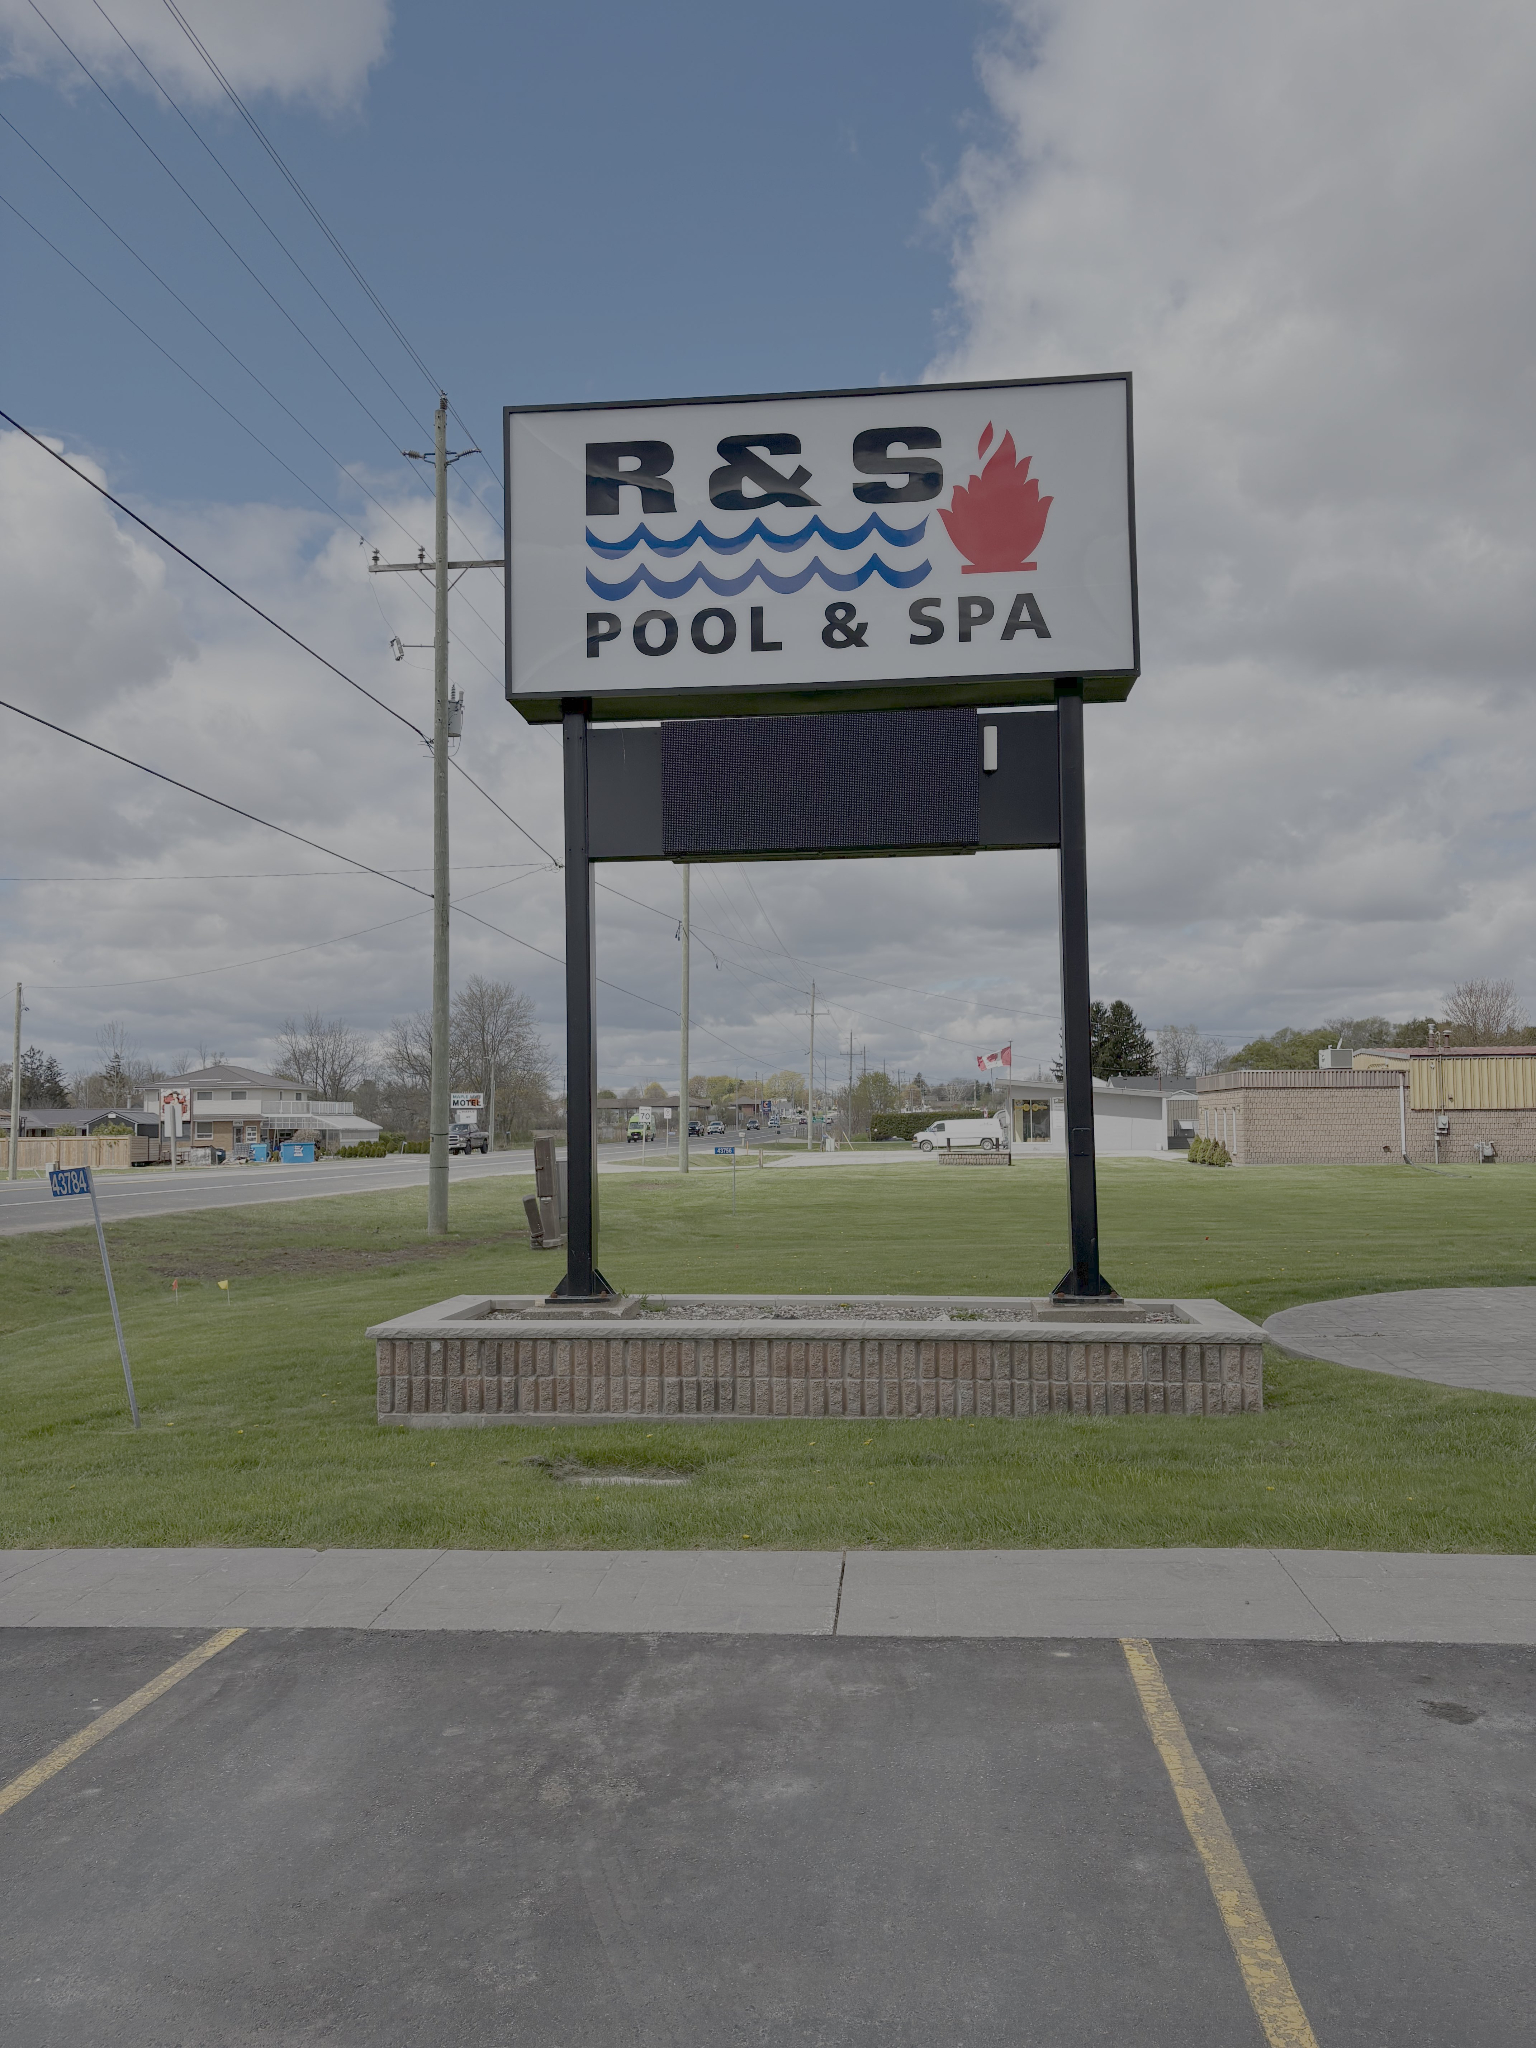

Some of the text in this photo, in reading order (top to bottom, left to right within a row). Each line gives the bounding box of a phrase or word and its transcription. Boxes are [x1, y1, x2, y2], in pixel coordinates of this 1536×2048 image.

[586, 592, 1052, 659] POOL & SPA
[640, 1112, 650, 1120] 70
[52, 1170, 87, 1196] 43784
